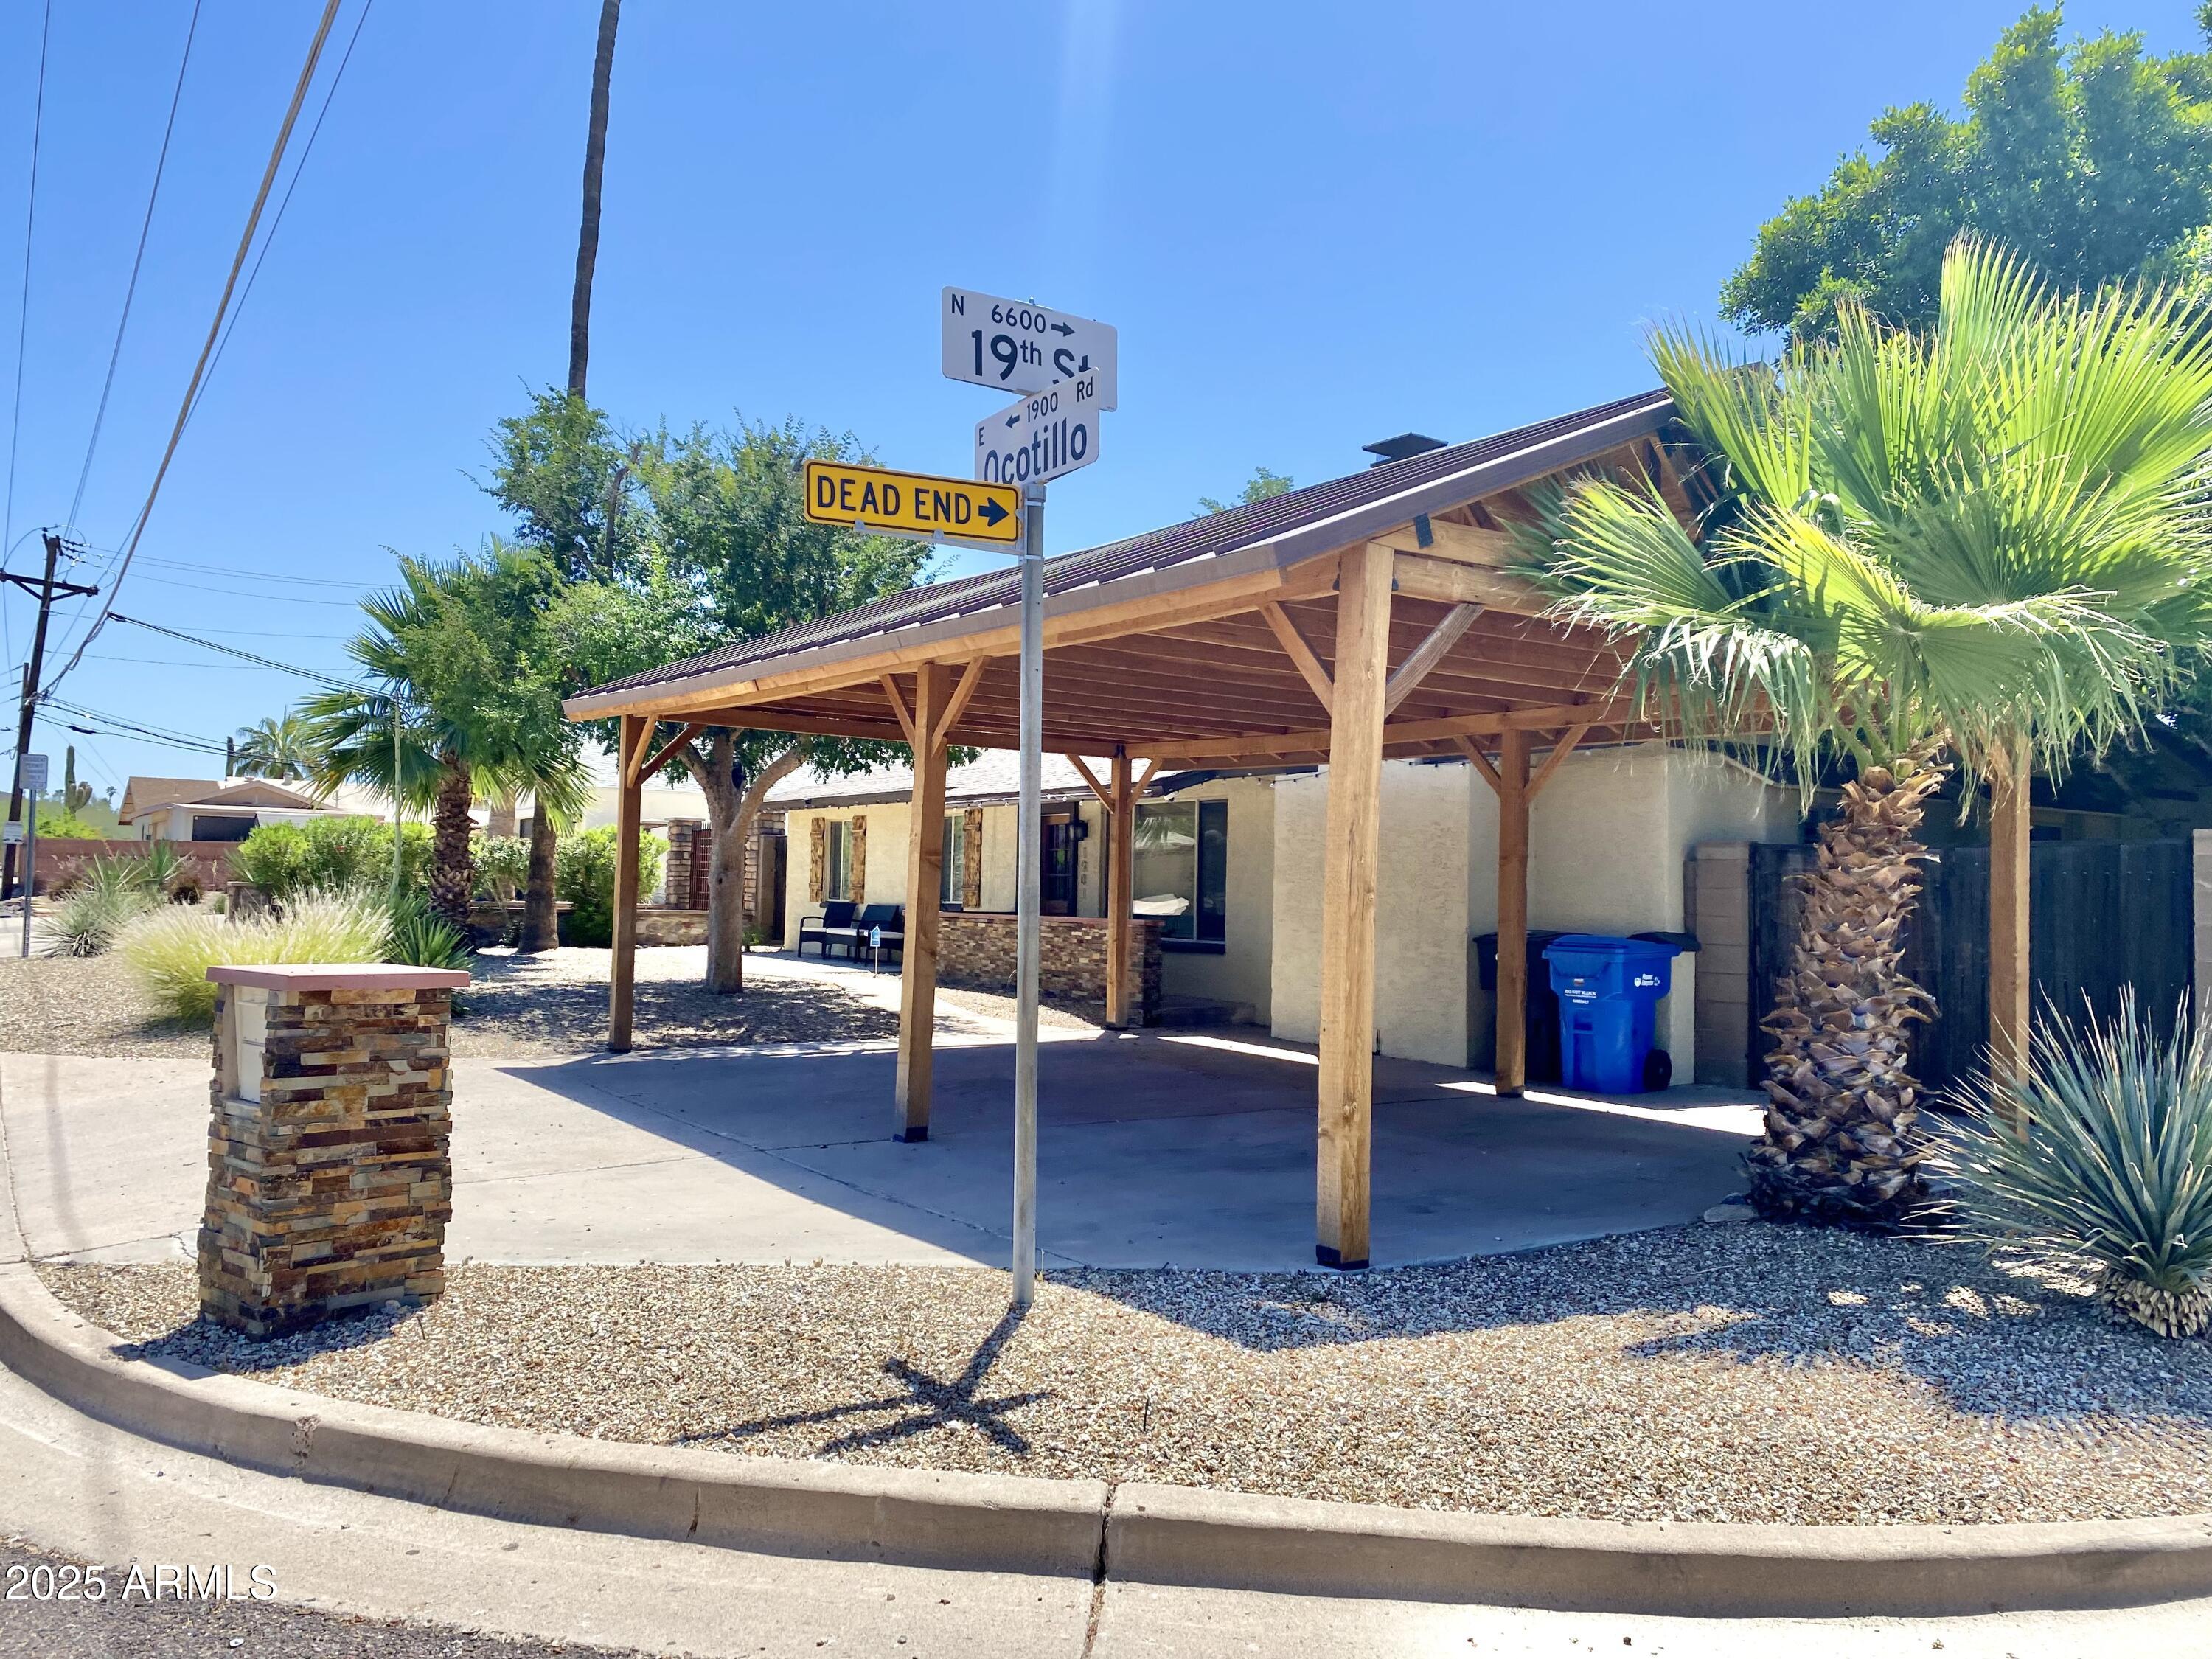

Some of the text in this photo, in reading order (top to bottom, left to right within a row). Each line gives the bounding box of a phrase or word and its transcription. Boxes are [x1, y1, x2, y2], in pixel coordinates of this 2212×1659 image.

[951, 293, 1046, 333] N 6600
[971, 330, 1042, 381] 19th
[978, 376, 1093, 447] E 1900 Rd
[984, 417, 1088, 484] Ocotillo
[818, 475, 971, 524] DEAD END
